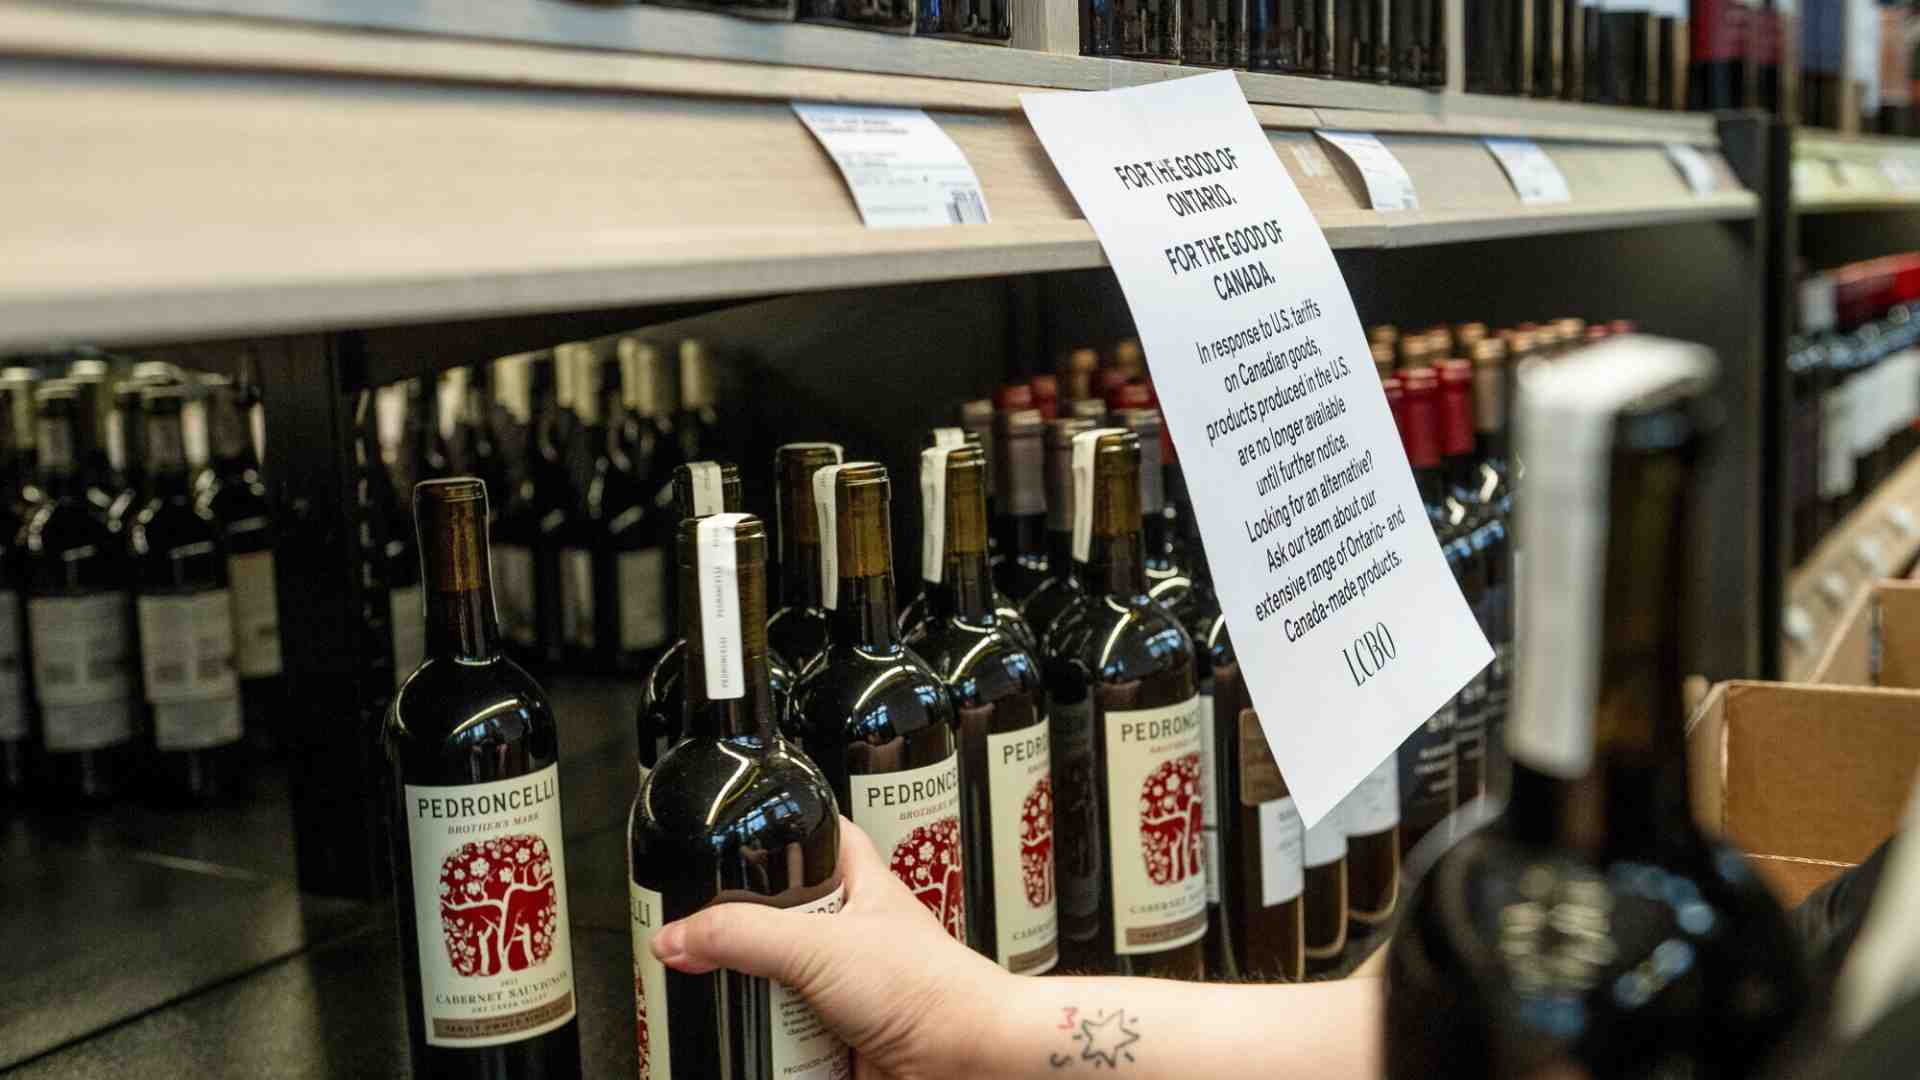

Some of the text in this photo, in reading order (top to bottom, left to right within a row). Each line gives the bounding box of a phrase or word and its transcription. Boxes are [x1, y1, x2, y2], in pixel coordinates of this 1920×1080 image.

[1114, 146, 1239, 190] FOR THE GOOD OF
[1166, 183, 1238, 217] ONTARIO.
[1164, 219, 1284, 275] FOR THE GOOD OF
[1213, 260, 1277, 301] CANADA.
[1196, 298, 1321, 364] In response to U.S. tariffs
[1224, 335, 1322, 393] on Canadian goods,
[1206, 355, 1352, 448] products produced in the U.S.
[1238, 395, 1347, 466] are no longer available
[1245, 449, 1375, 543] Looking for an alternative?
[1256, 434, 1350, 497] until further notice.
[1255, 503, 1406, 622] extensive range of Ontario- and
[1266, 490, 1377, 573] Ask our team about our
[1284, 549, 1403, 643] Canada-made products.
[1342, 622, 1396, 687] LCBO
[417, 775, 555, 818] PEDRONCELLI
[435, 991, 503, 1006] CABERNET
